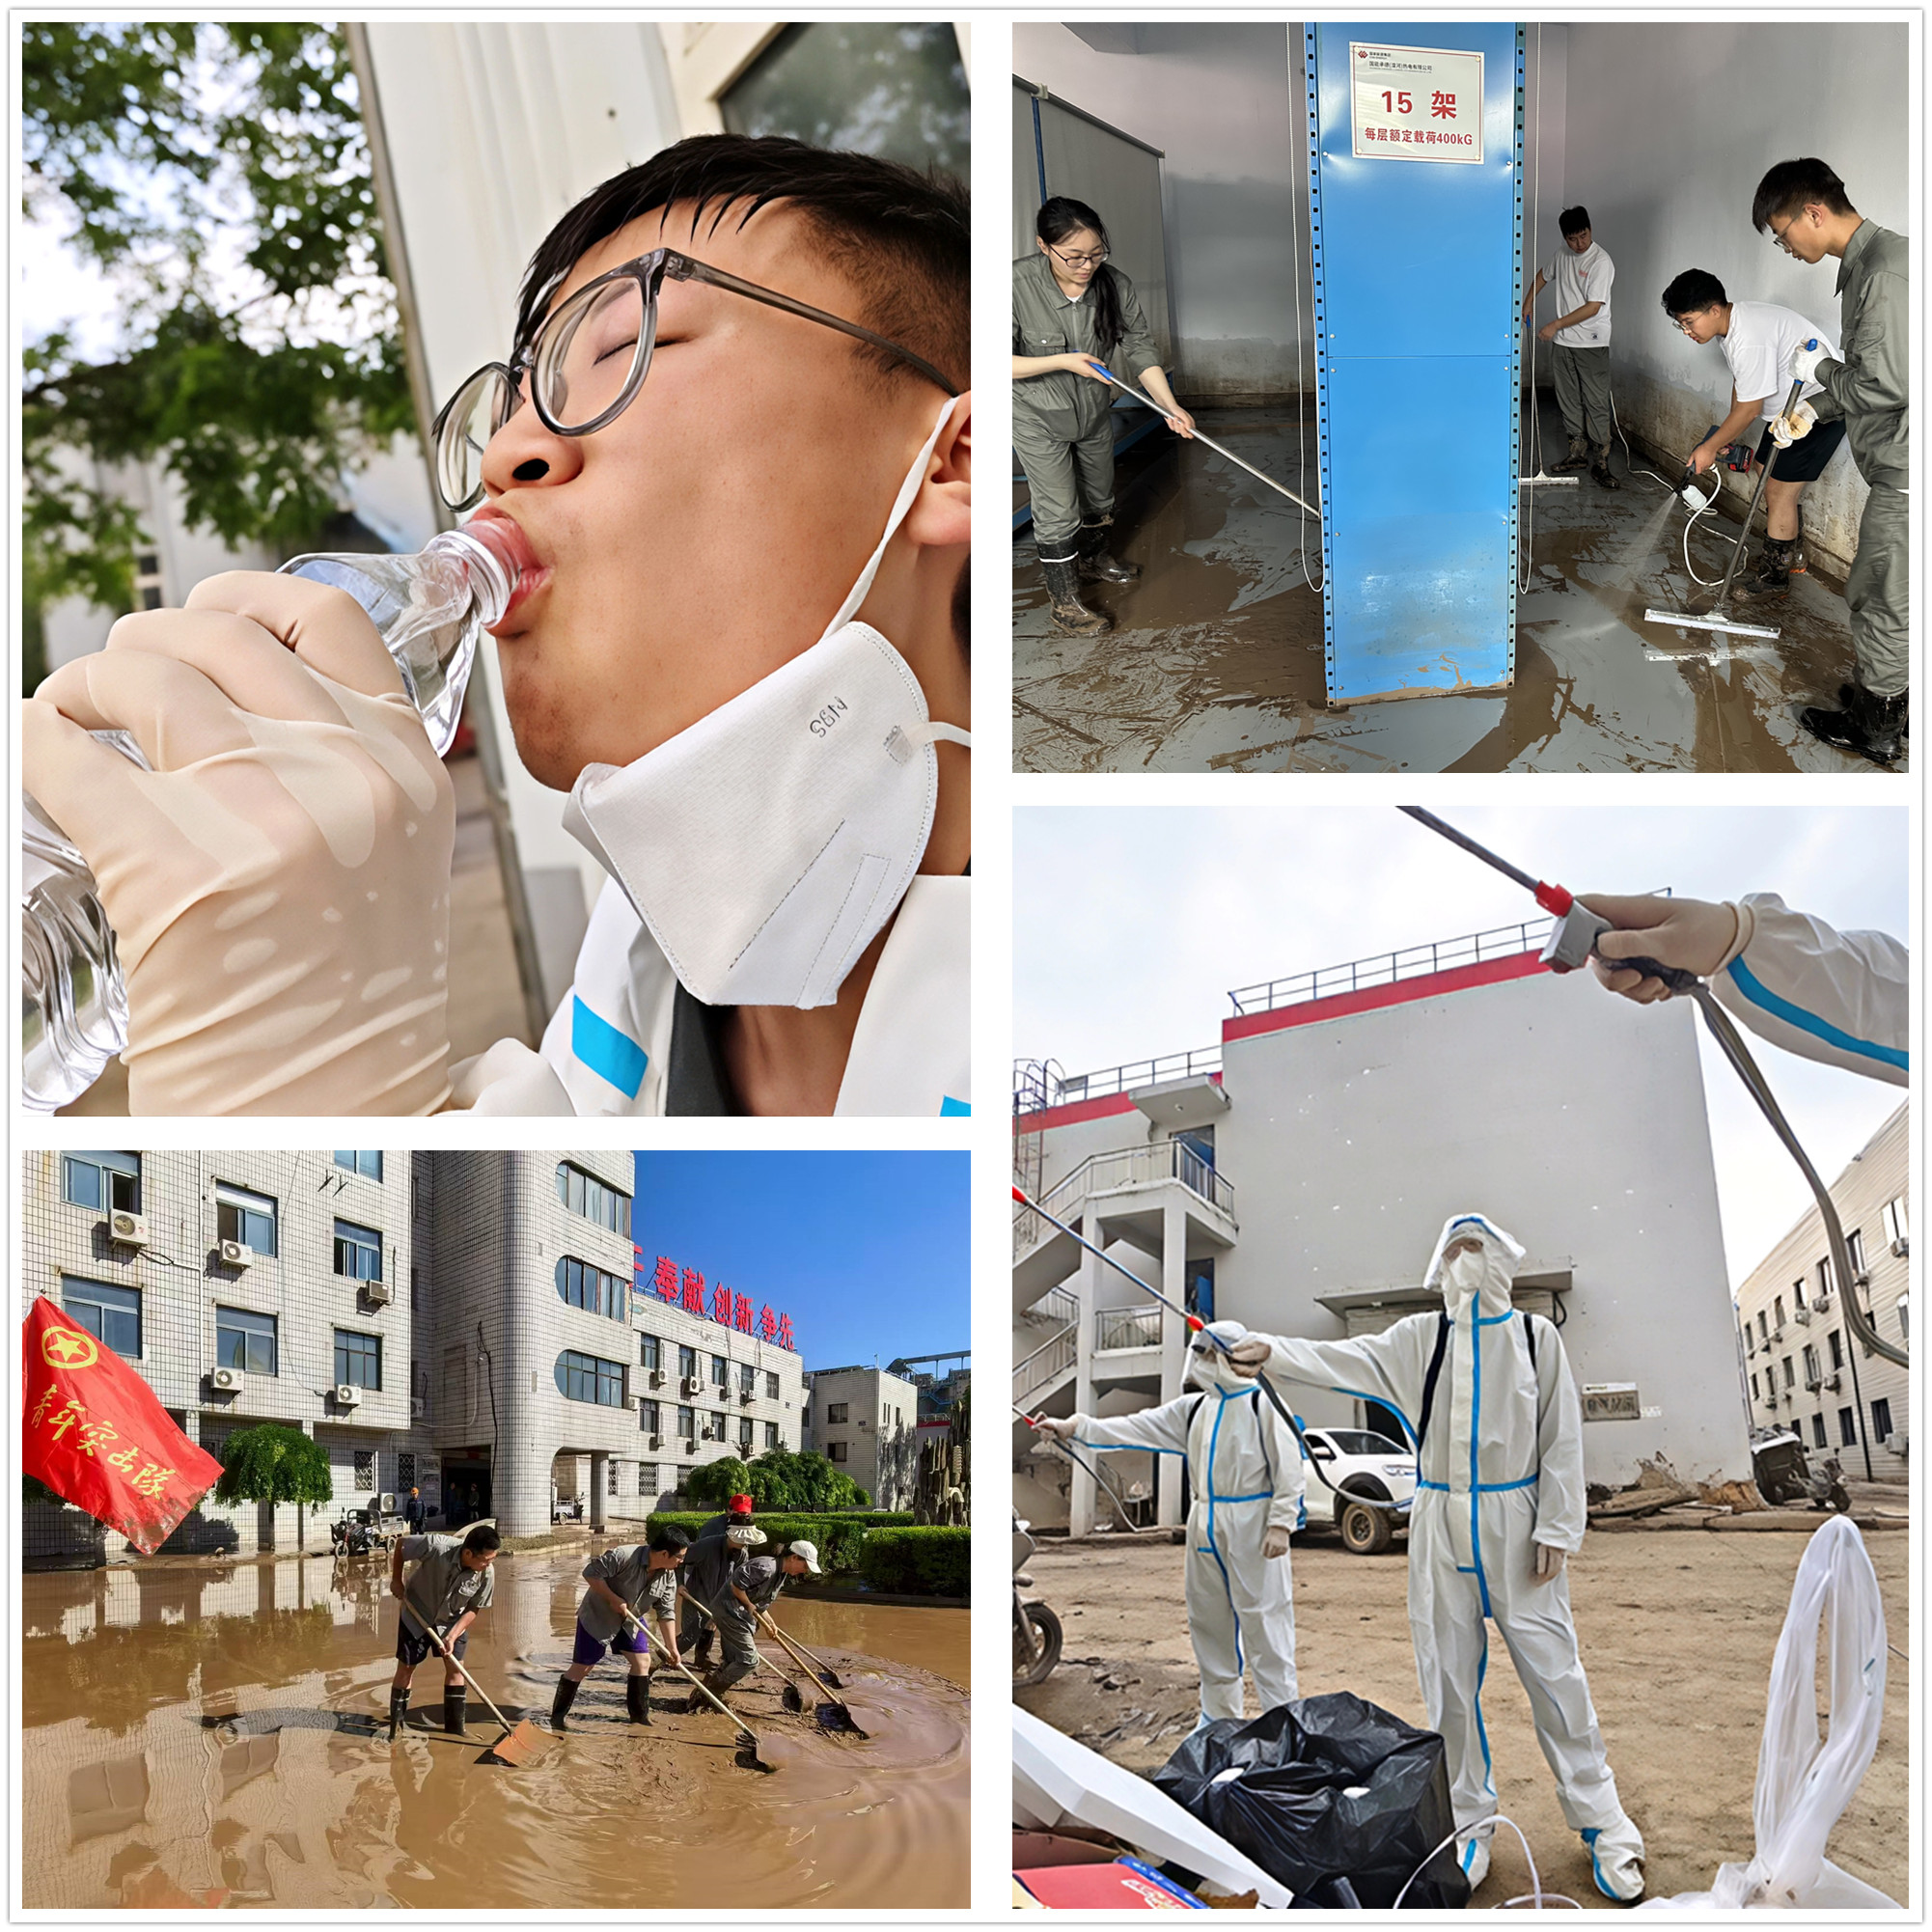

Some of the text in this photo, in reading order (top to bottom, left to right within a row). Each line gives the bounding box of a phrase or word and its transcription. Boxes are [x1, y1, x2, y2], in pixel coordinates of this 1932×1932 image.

[1381, 90, 1457, 120] 15 架
[1365, 126, 1473, 146] 每层额定载荷400kG
[654, 1256, 705, 1315] 奉献
[713, 1282, 755, 1336] 创新
[760, 1304, 795, 1351] 争先
